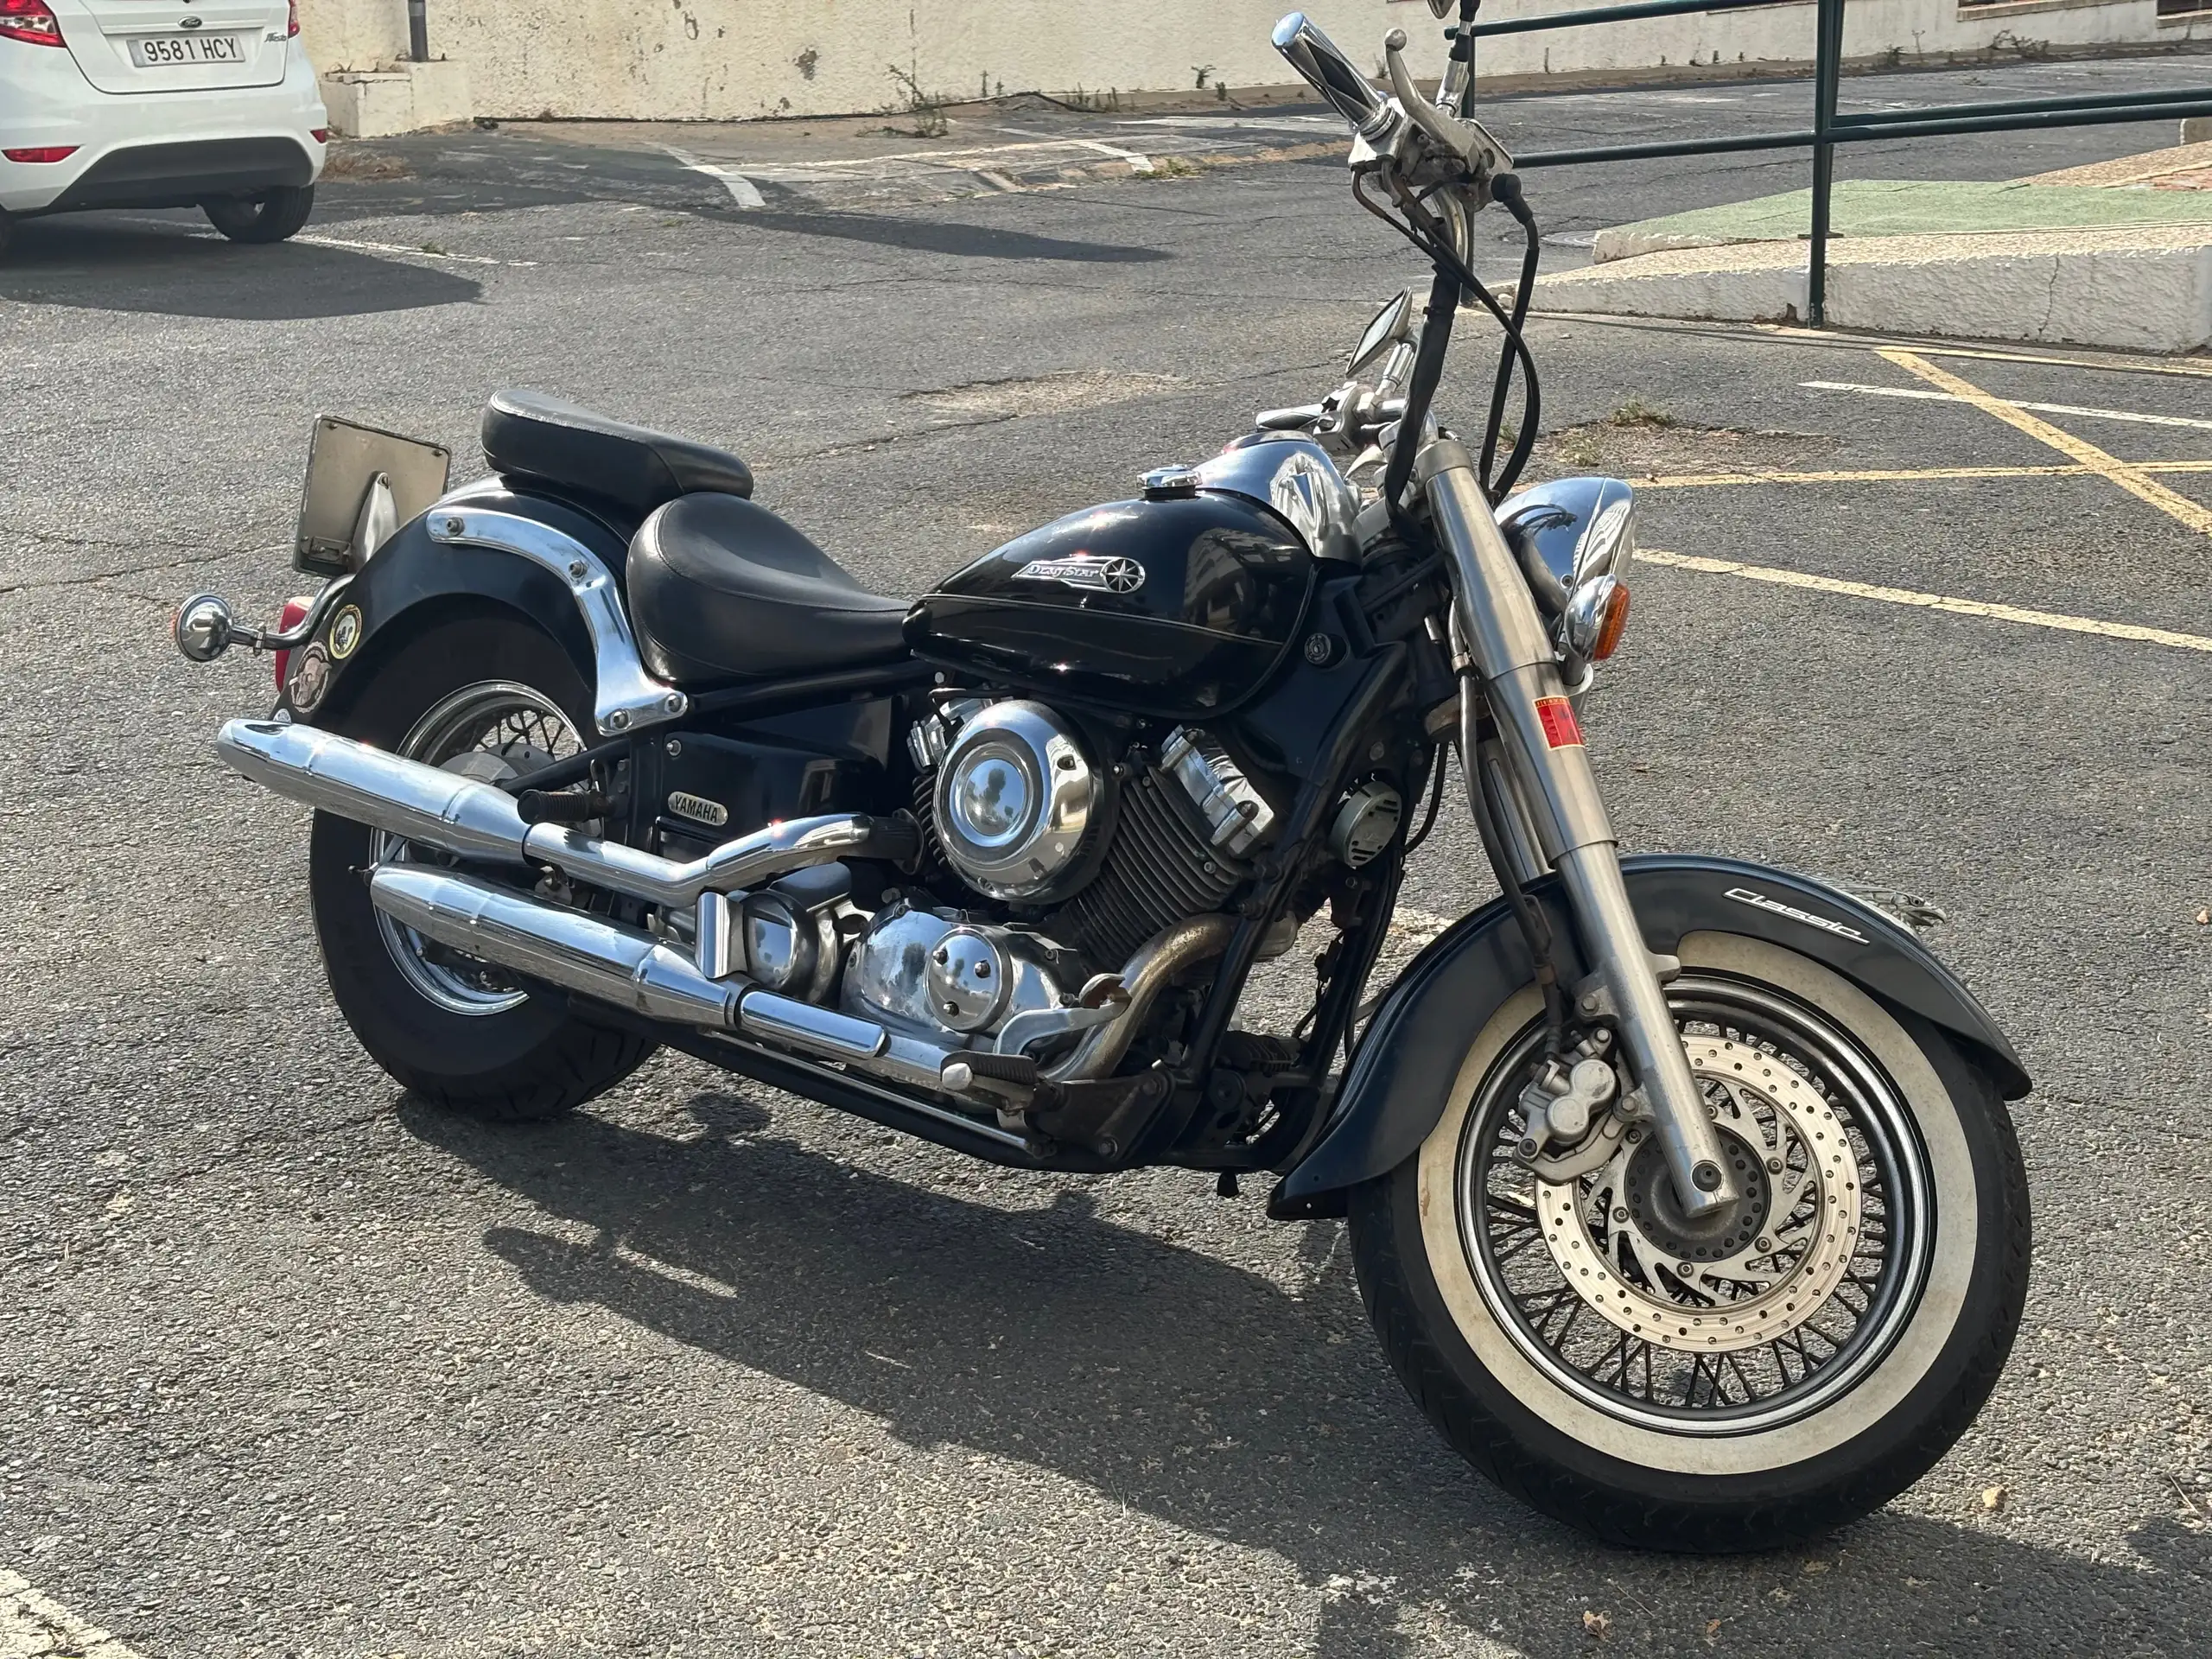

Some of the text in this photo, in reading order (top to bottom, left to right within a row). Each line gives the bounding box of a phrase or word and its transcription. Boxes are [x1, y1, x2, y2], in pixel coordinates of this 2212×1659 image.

[144, 38, 236, 61] 9581 HCY
[675, 795, 718, 823] YAMAHA
[1722, 887, 1870, 945] Classic
